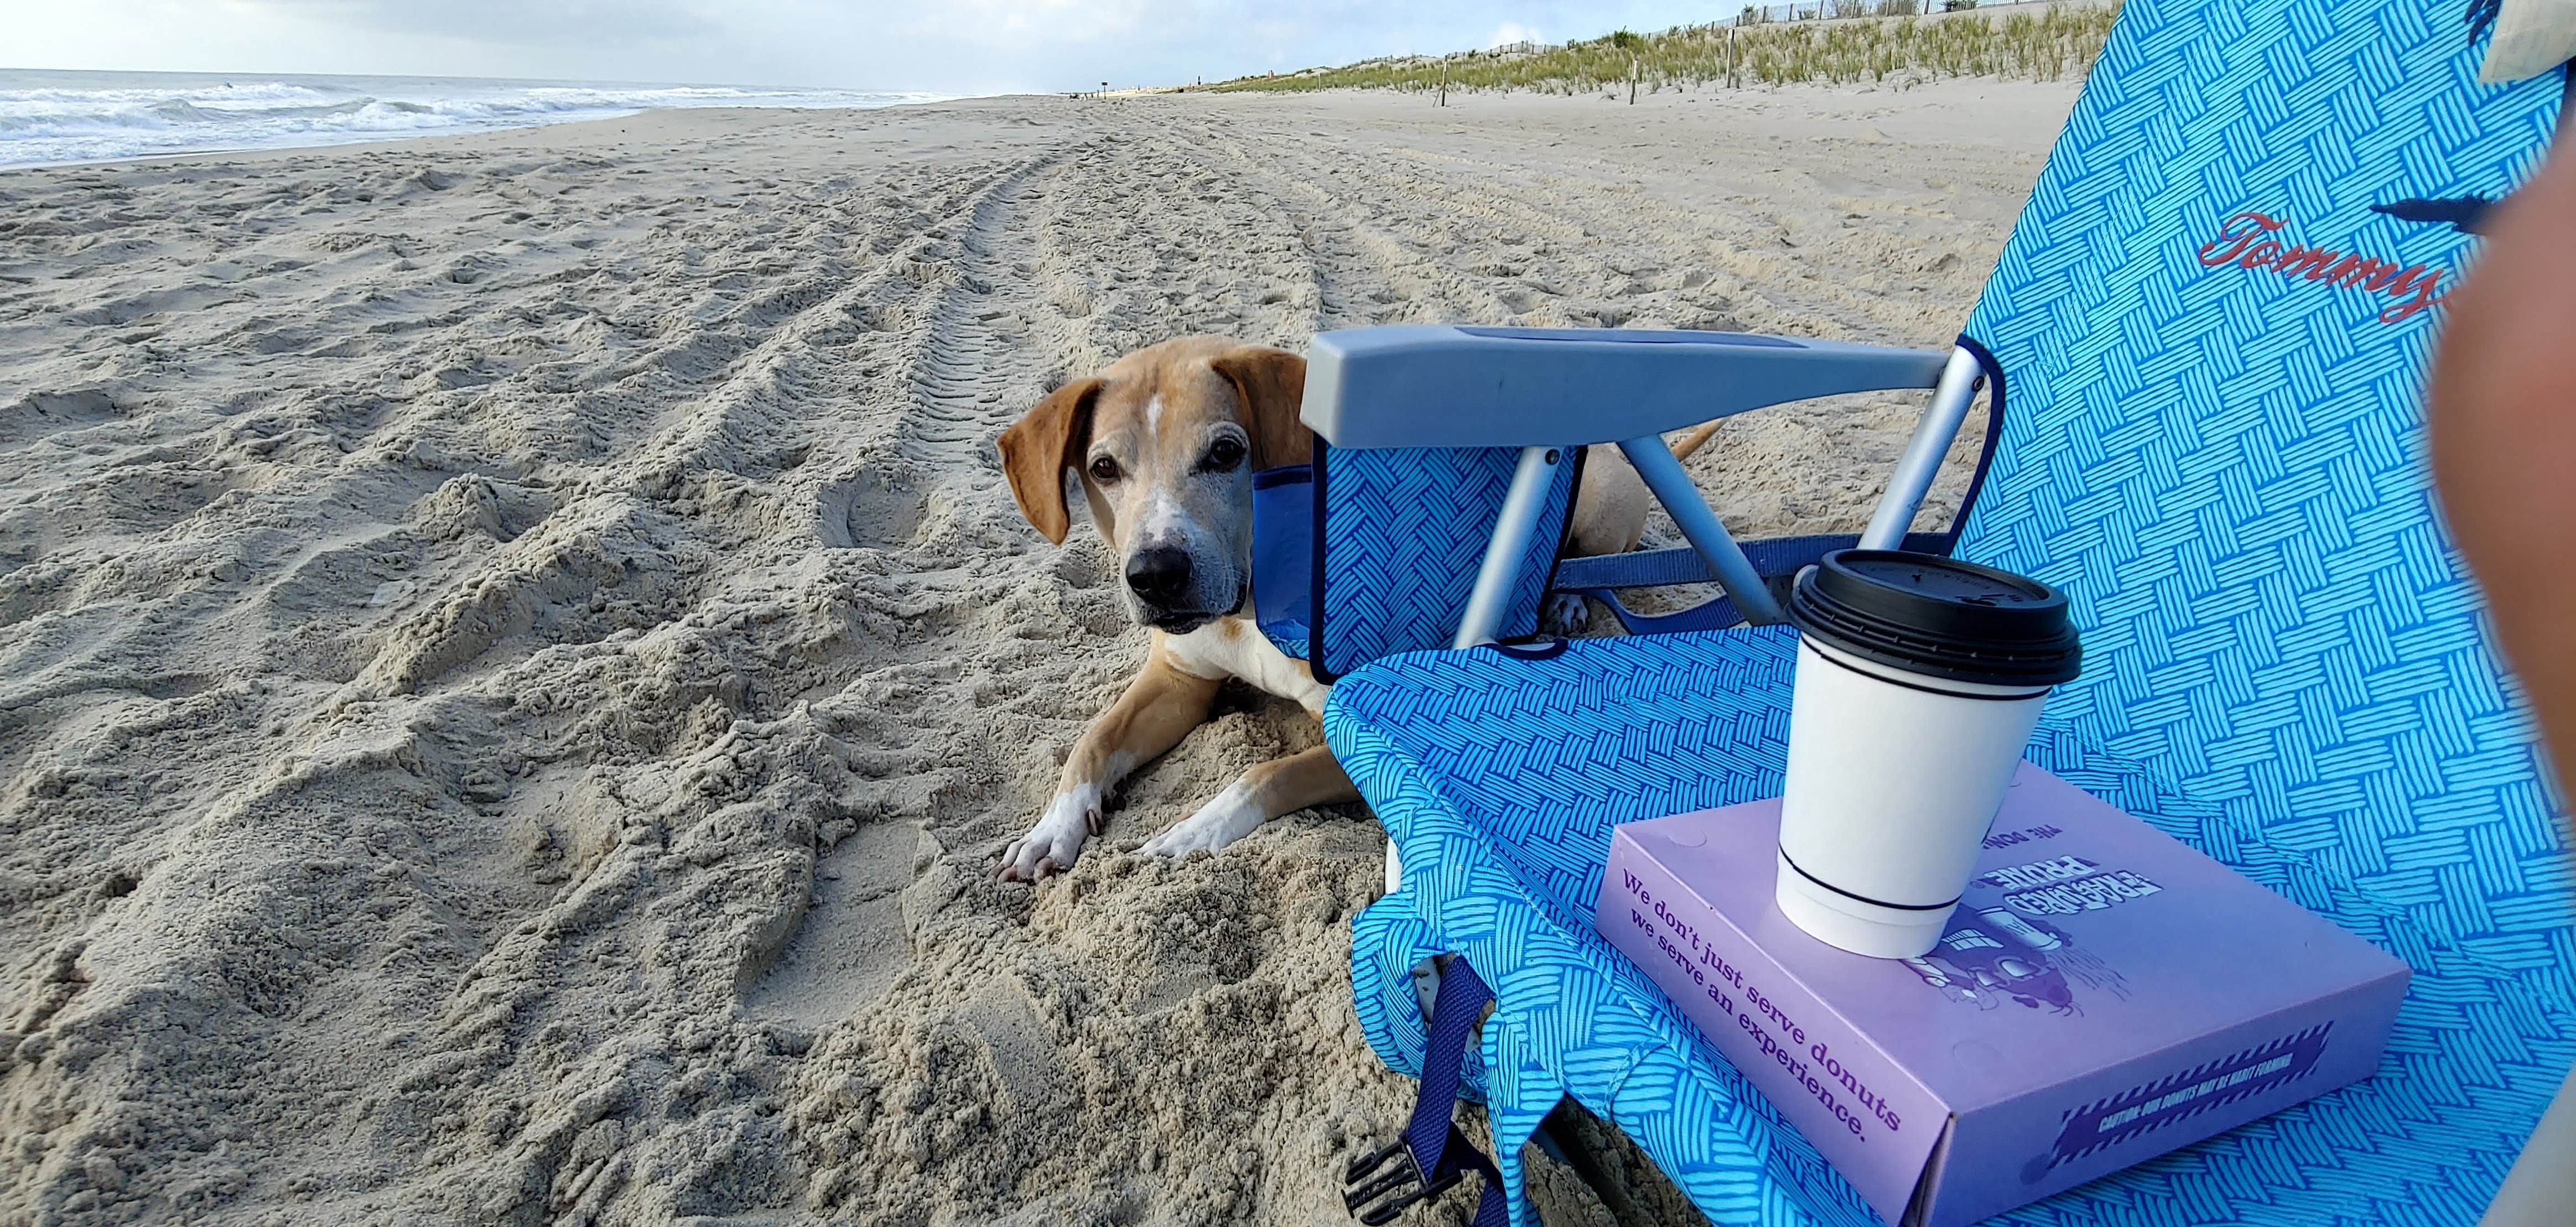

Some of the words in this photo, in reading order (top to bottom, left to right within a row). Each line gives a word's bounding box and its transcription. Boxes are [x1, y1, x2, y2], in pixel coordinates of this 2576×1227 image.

[2198, 211, 2448, 323] Tommy
[2026, 824, 2063, 839] THE
[1984, 855, 2097, 890] PRUNE
[2003, 870, 2164, 916] FRACTURED
[1623, 867, 1650, 904] We
[1654, 900, 1700, 950] don't
[1700, 942, 1743, 989] just
[1746, 986, 1805, 1045] serve
[1810, 1043, 1901, 1132] donuts
[1630, 908, 1654, 938] we
[1658, 935, 1704, 986] serve
[1707, 984, 1734, 1016] an
[1738, 1013, 1865, 1142] experience.
[2160, 1084, 2199, 1109] DONUTS
[2196, 1078, 2218, 1097] MAY
[2215, 1074, 2231, 1091] BE
